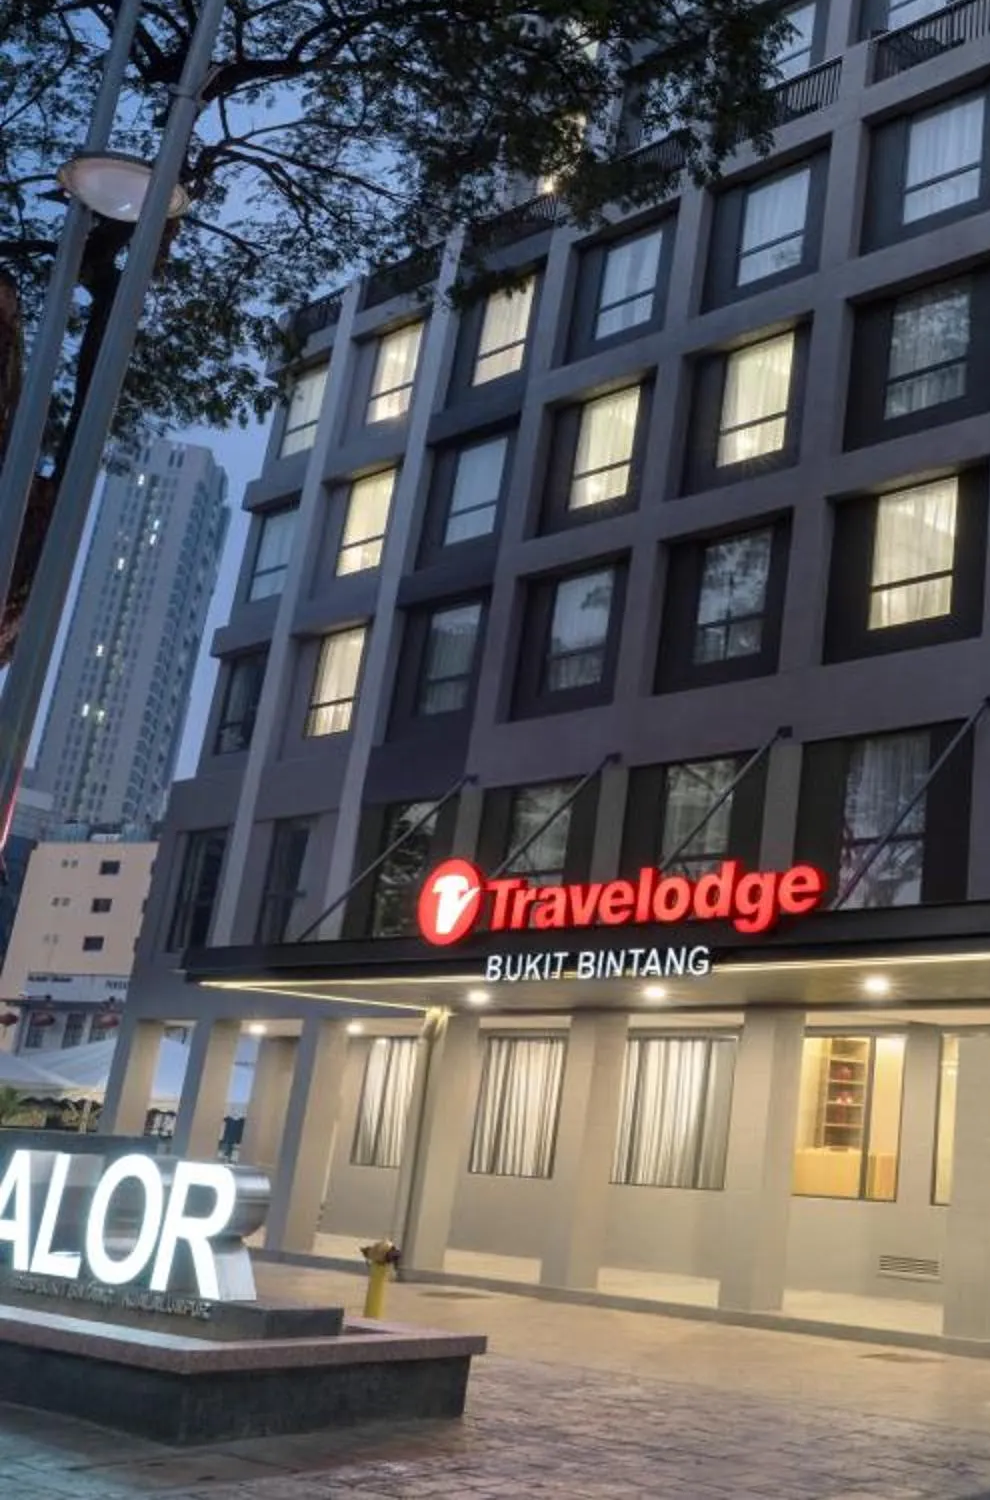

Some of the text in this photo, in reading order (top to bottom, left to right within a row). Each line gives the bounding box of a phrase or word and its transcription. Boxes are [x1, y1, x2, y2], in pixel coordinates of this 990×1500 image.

[486, 859, 823, 933] Travelodge
[485, 946, 709, 982] BUKIT BINTANG
[0, 1149, 237, 1301] ALOR
